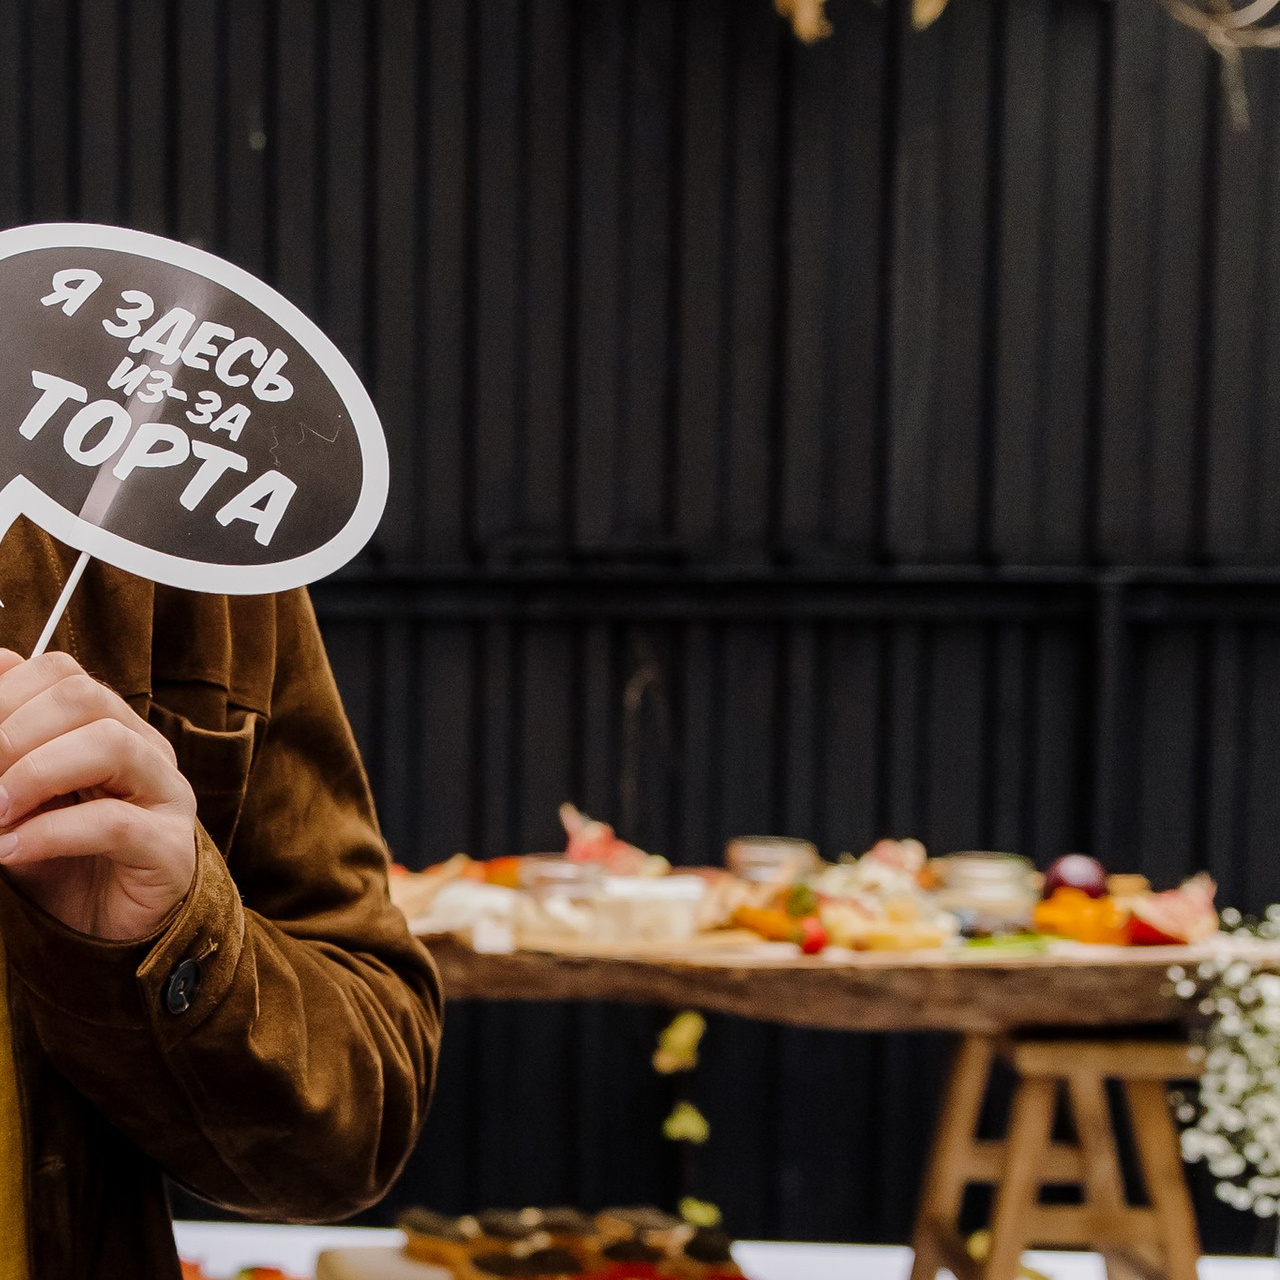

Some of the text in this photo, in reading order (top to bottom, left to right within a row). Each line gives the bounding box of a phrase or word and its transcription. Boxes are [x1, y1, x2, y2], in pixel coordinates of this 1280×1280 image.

[40, 268, 294, 402] Я ЗДЕСЬ
[107, 356, 251, 442] ИЗ-ЗА
[19, 370, 298, 546] ТОРТА
